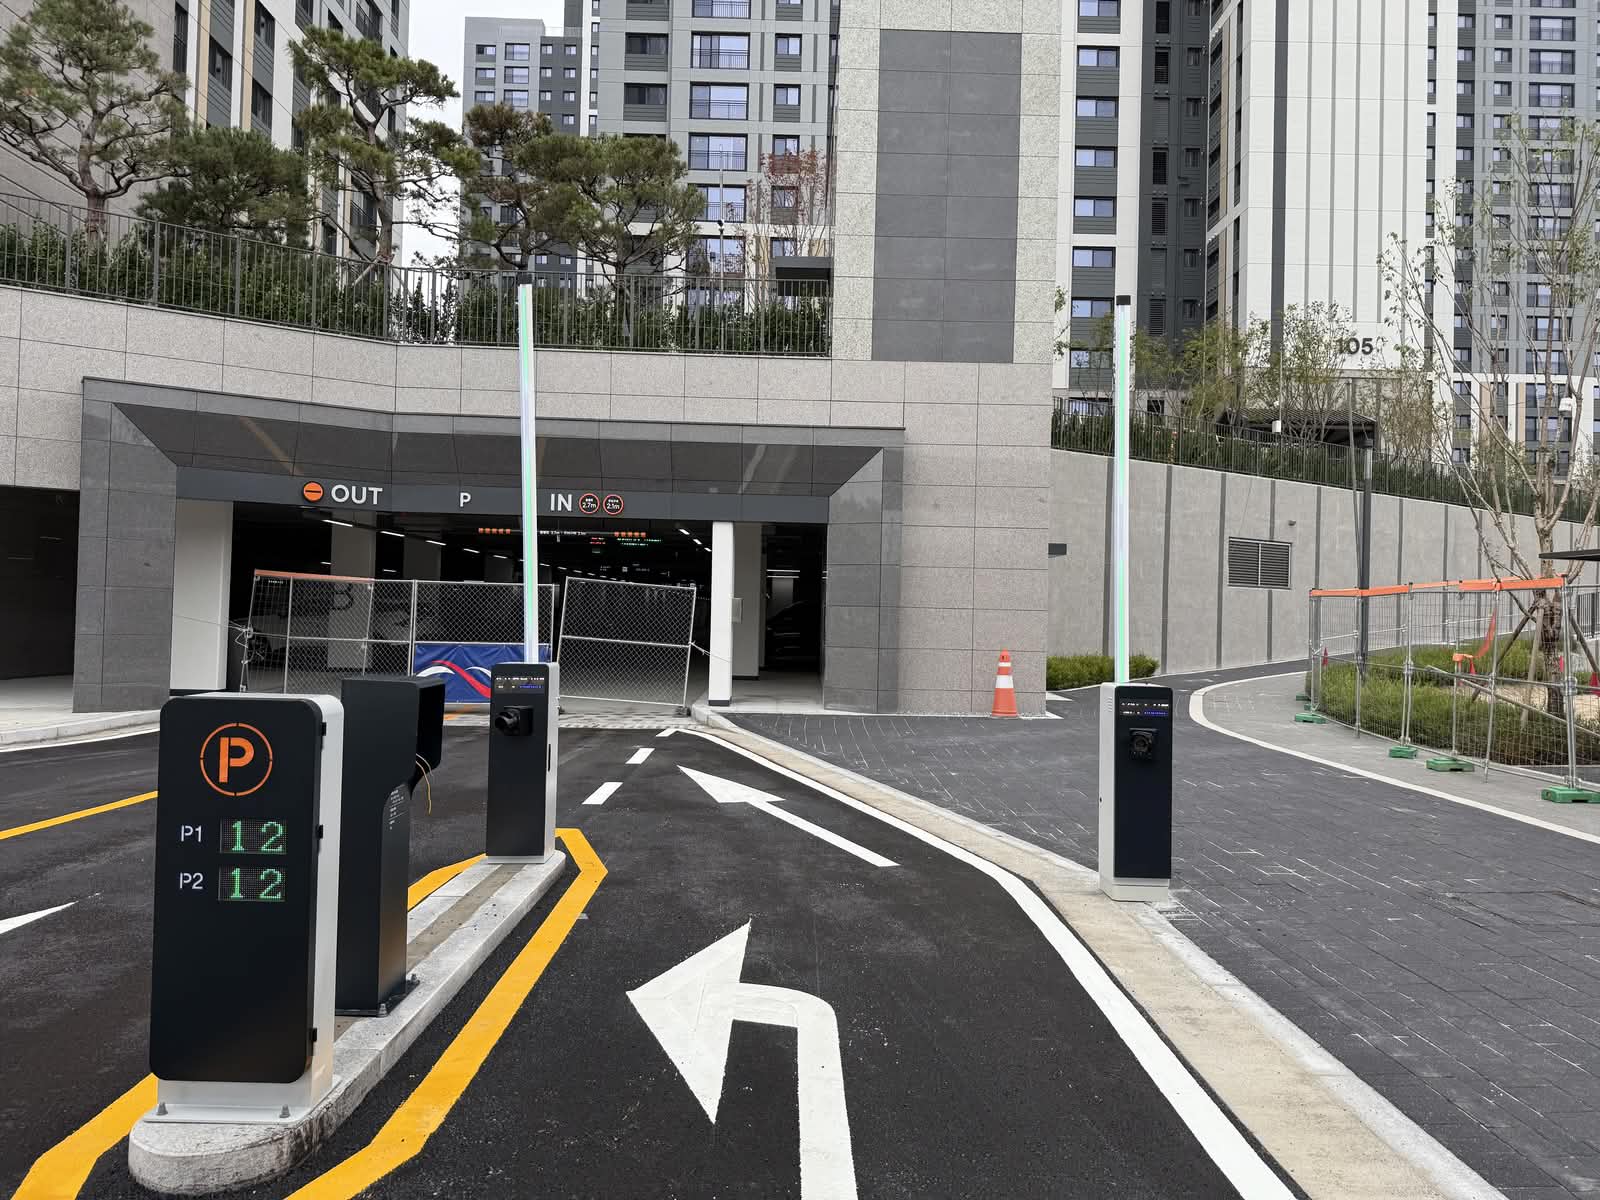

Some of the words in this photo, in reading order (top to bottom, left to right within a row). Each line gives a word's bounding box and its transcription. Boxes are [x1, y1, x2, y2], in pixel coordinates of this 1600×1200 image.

[1335, 337, 1374, 355] 105
[330, 484, 383, 505] OUT
[459, 492, 472, 507] P
[550, 493, 573, 511] IN
[218, 736, 255, 783] P
[180, 825, 203, 843] P1
[179, 872, 204, 890] P2
